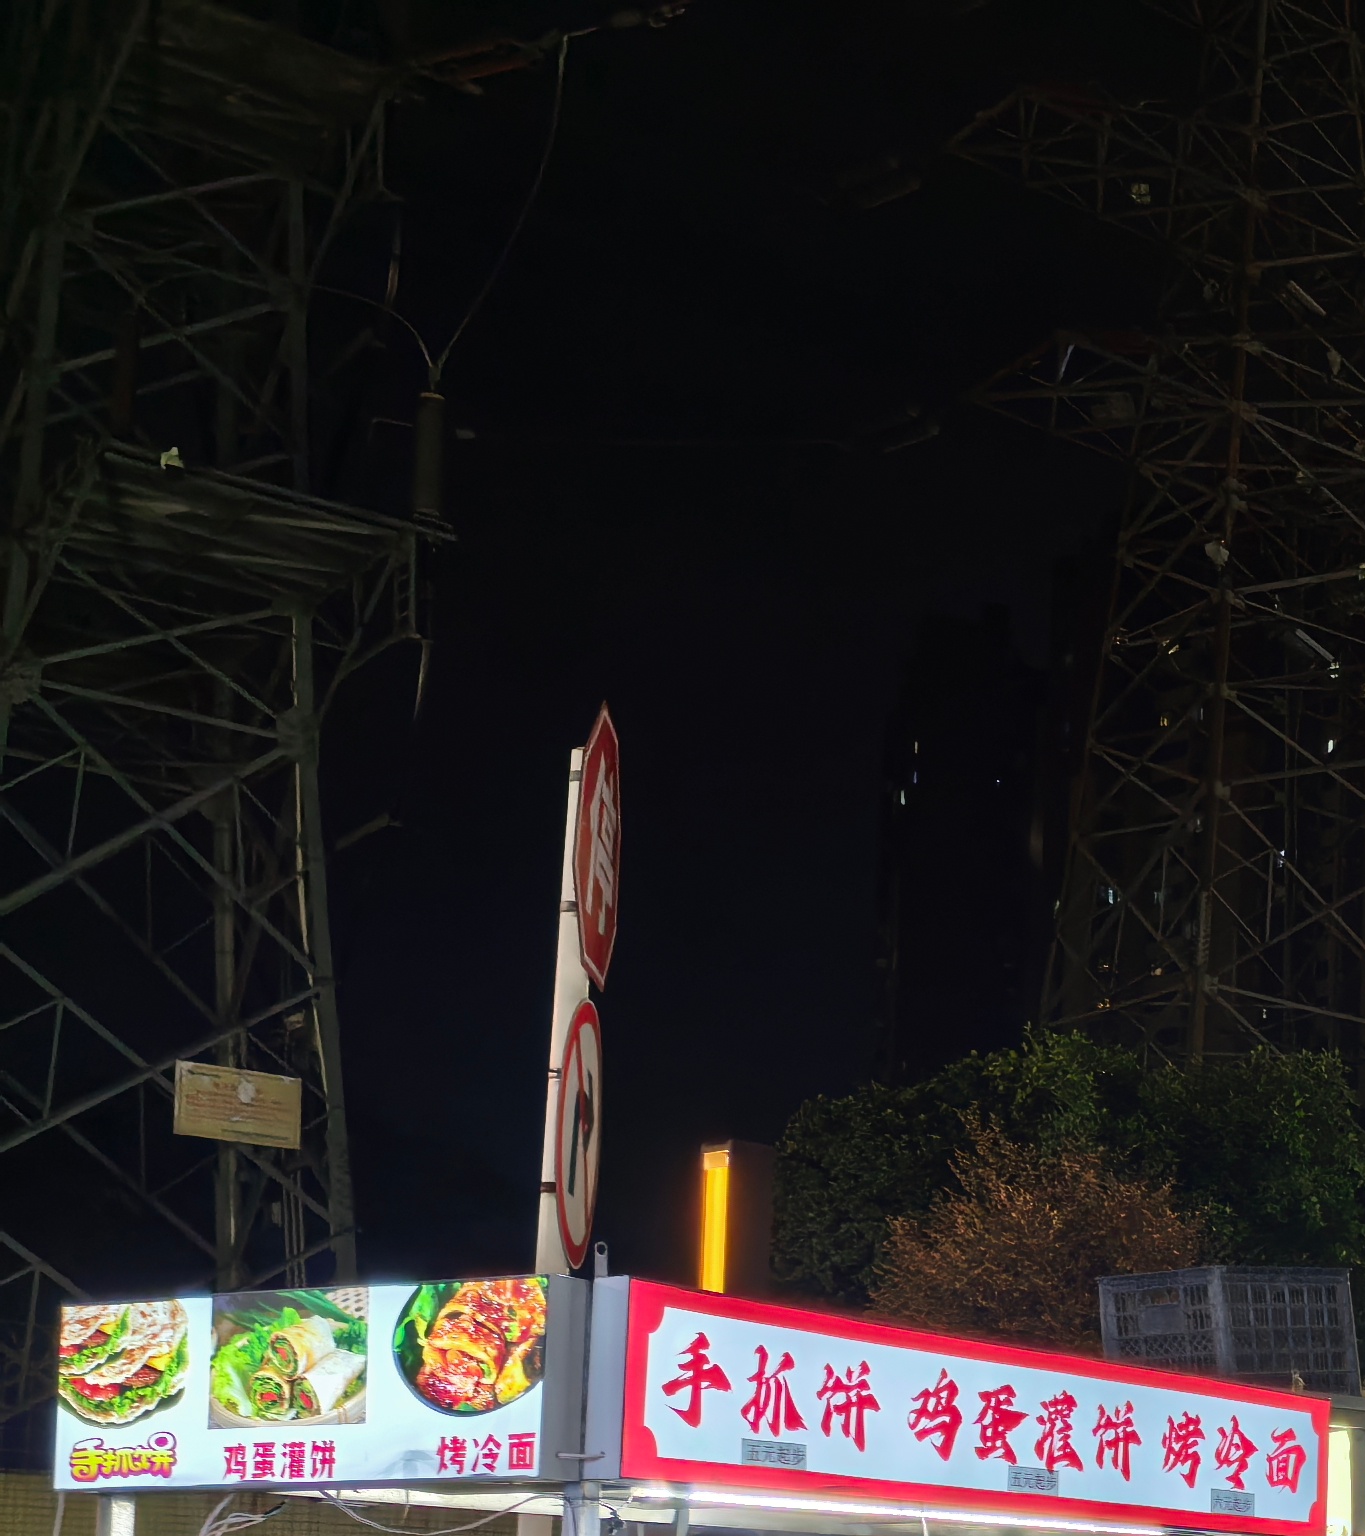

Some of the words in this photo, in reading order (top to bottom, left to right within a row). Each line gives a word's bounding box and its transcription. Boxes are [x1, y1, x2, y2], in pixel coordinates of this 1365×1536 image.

[585, 751, 617, 936] 停
[661, 1331, 881, 1453] 手抓饼
[908, 1367, 1143, 1483] 鸡蛋灌饼
[1160, 1410, 1307, 1494] 烤冷面
[70, 1431, 177, 1482] 手抓饼
[222, 1440, 336, 1480] 鸡蛋灌饼
[435, 1432, 537, 1475] 烤冷面
[746, 1443, 804, 1467] 五元起步
[1011, 1467, 1058, 1491] 五元起步
